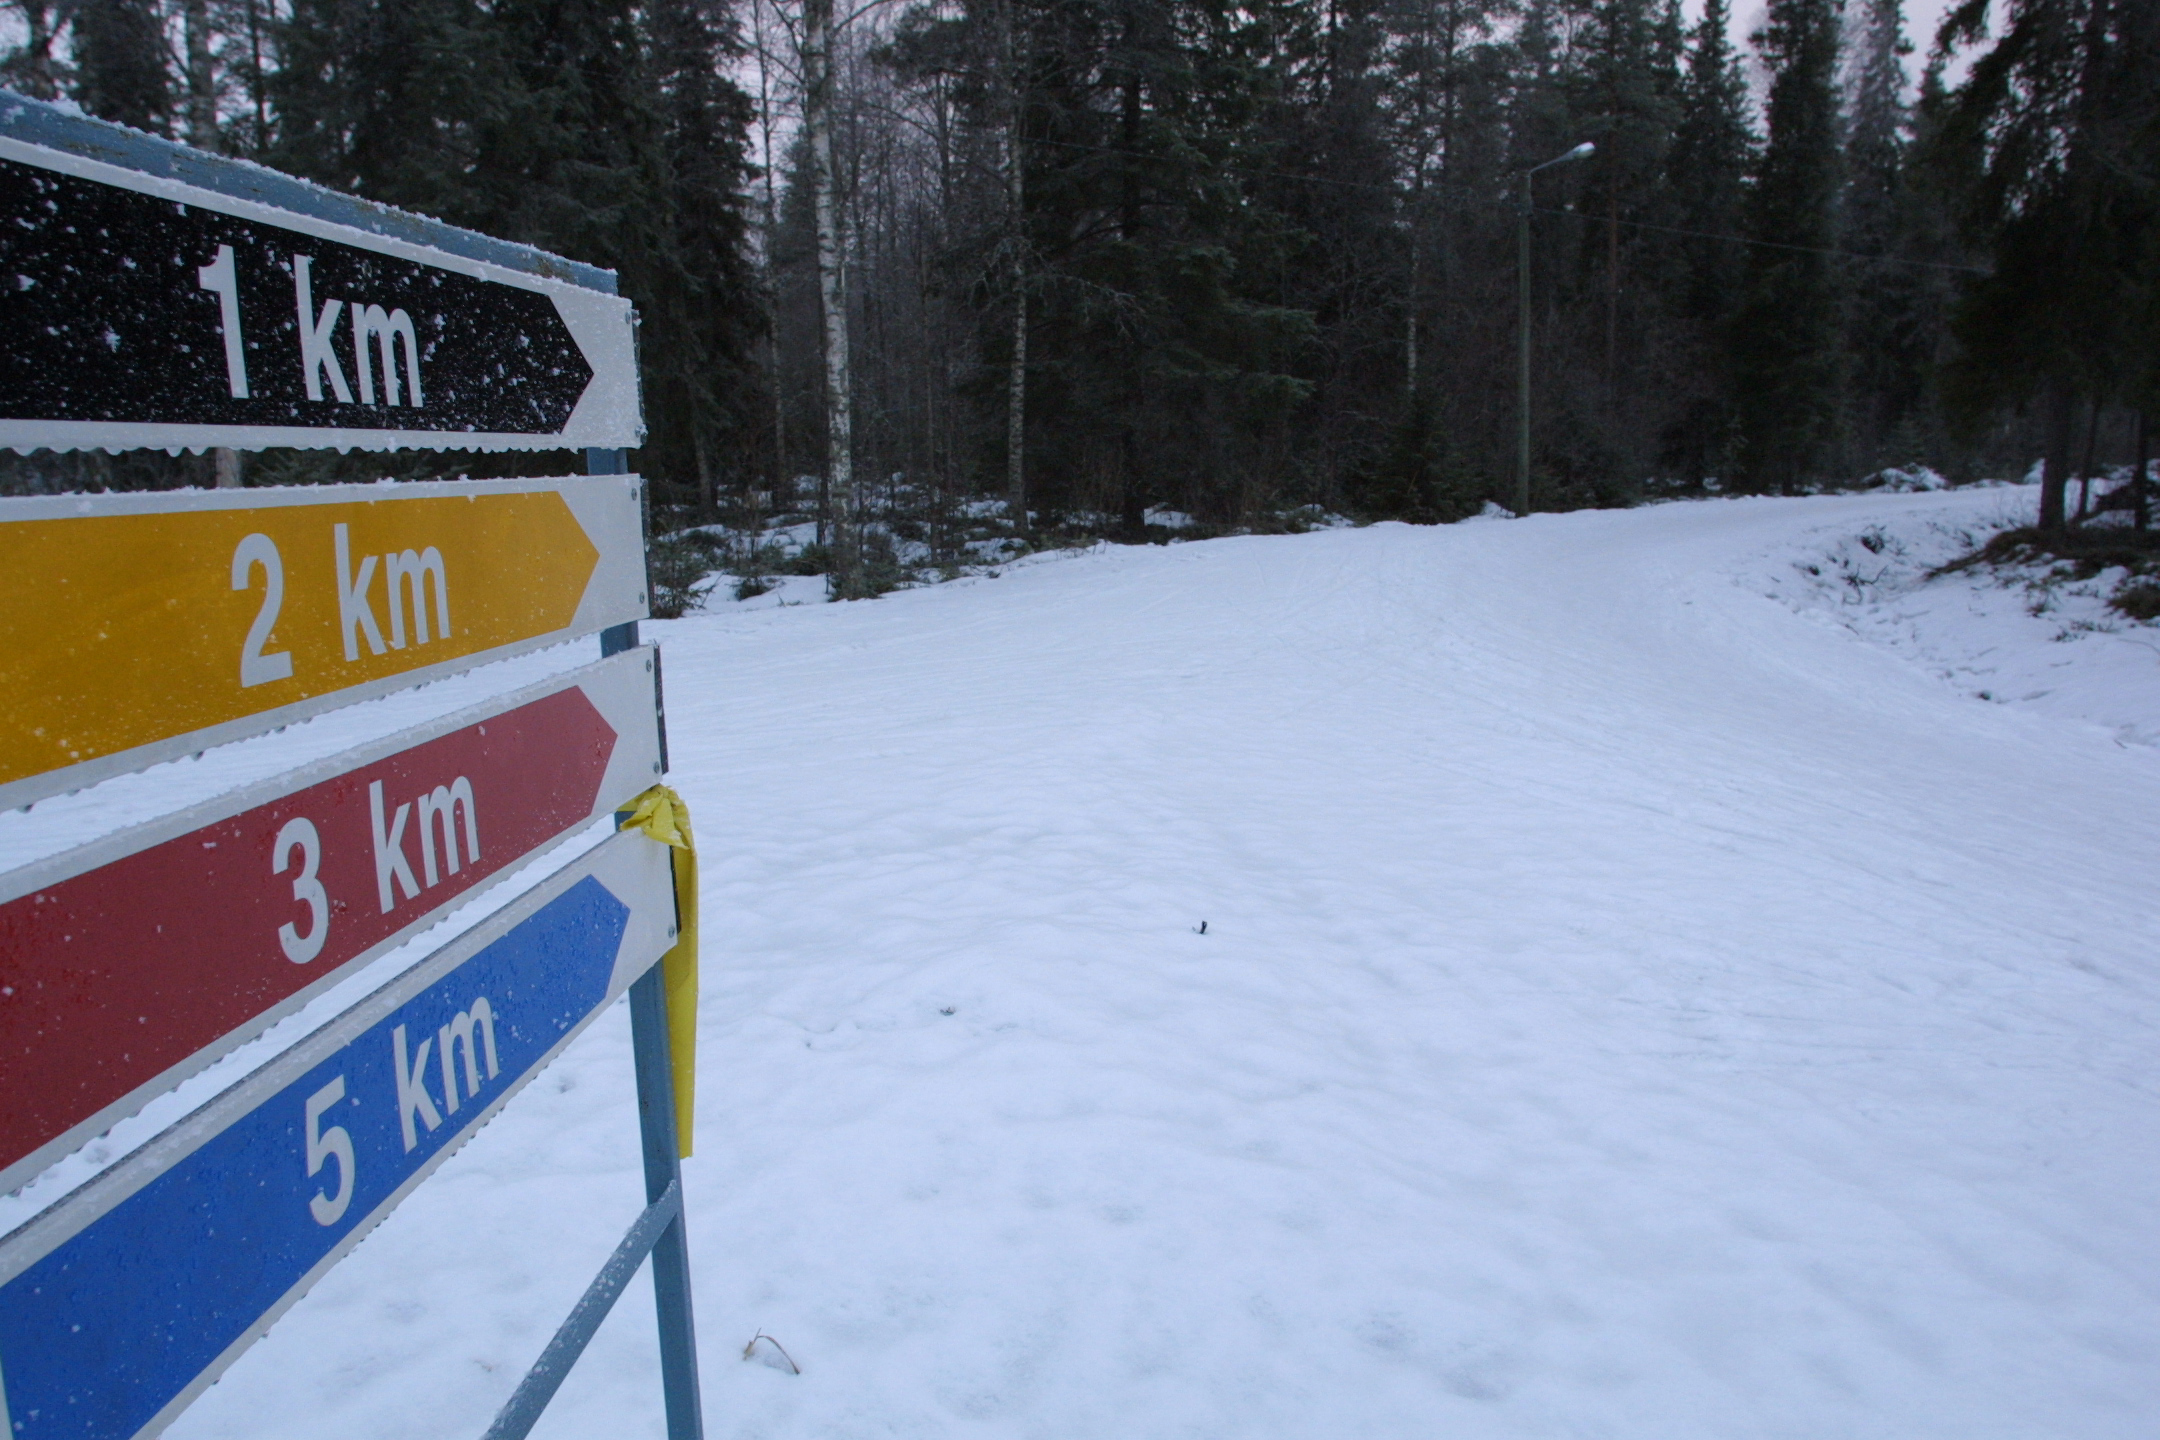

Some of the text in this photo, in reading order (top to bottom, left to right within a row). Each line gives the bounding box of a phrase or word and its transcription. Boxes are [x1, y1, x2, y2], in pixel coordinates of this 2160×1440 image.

[198, 244, 424, 408] 1 km
[231, 522, 451, 688] 2 km
[271, 775, 481, 964] 3 km
[304, 996, 499, 1227] 5 km
